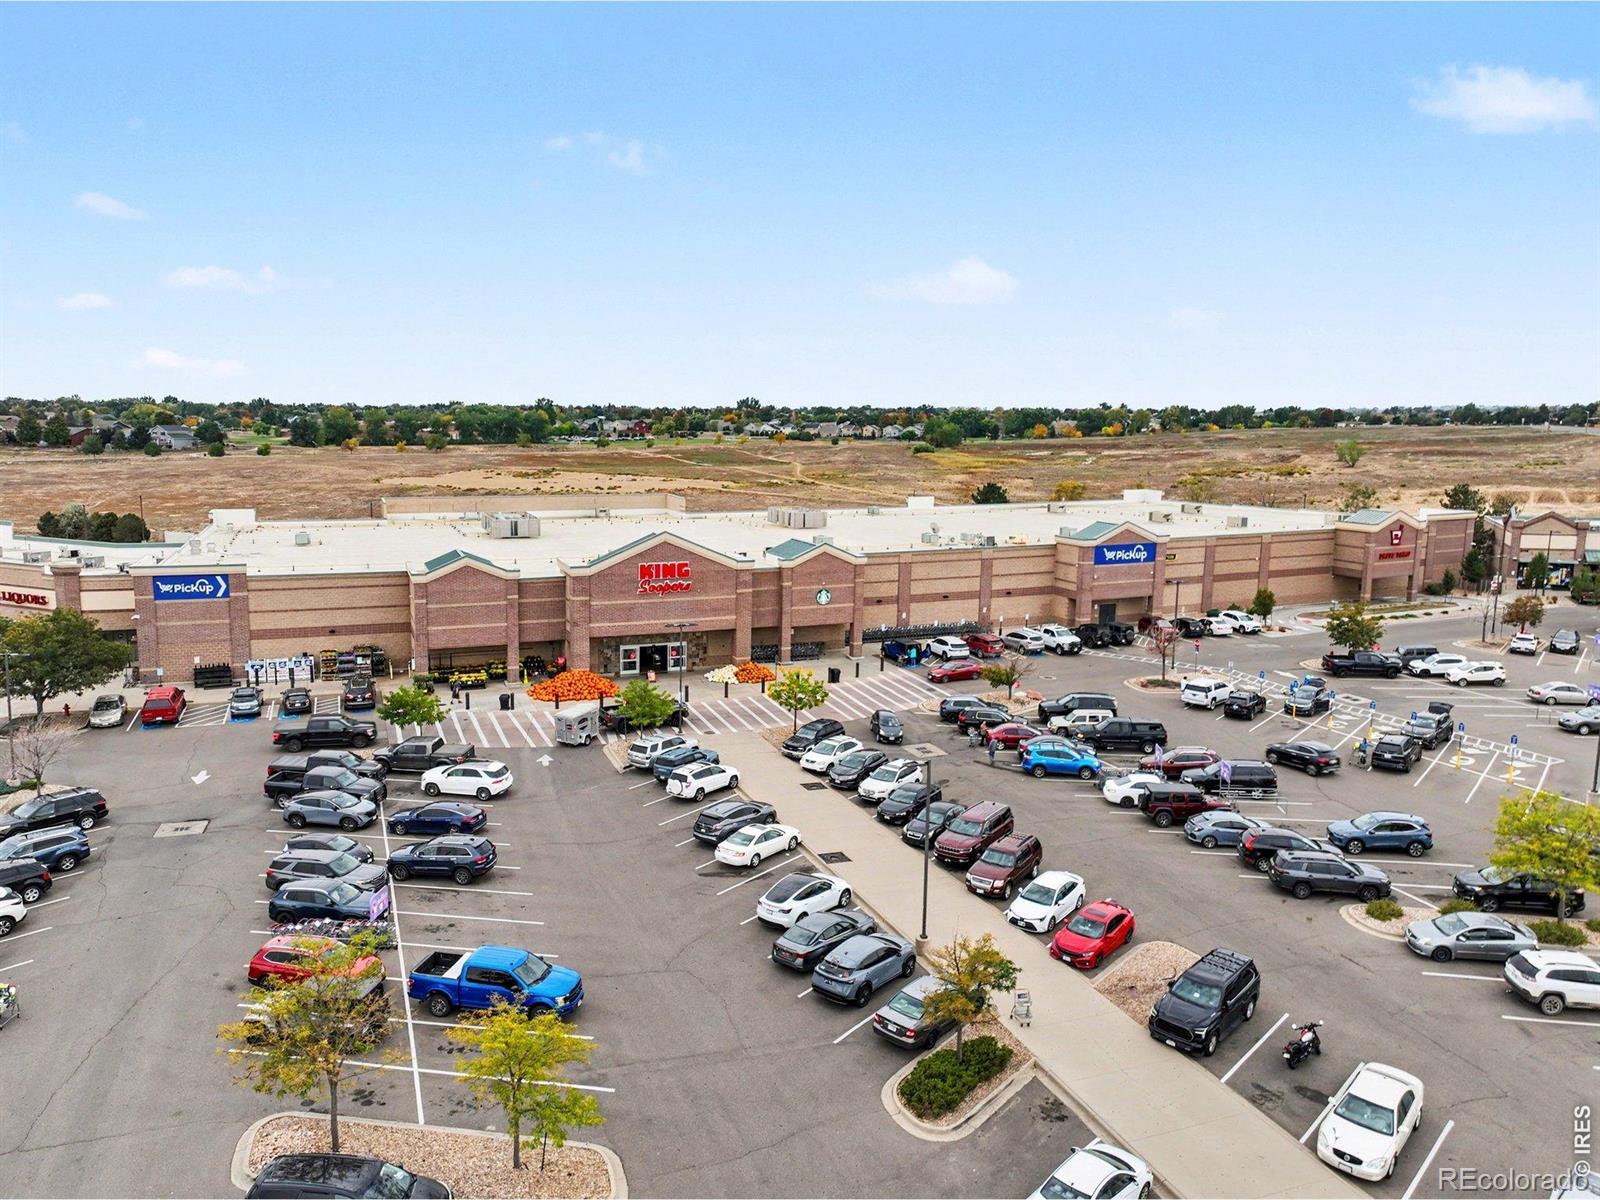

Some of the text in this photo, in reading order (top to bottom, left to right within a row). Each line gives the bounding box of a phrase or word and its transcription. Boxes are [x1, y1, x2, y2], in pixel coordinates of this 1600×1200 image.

[639, 561, 691, 580] KING
[637, 579, 692, 597] Soopers
[1, 592, 49, 605] LIQUORS
